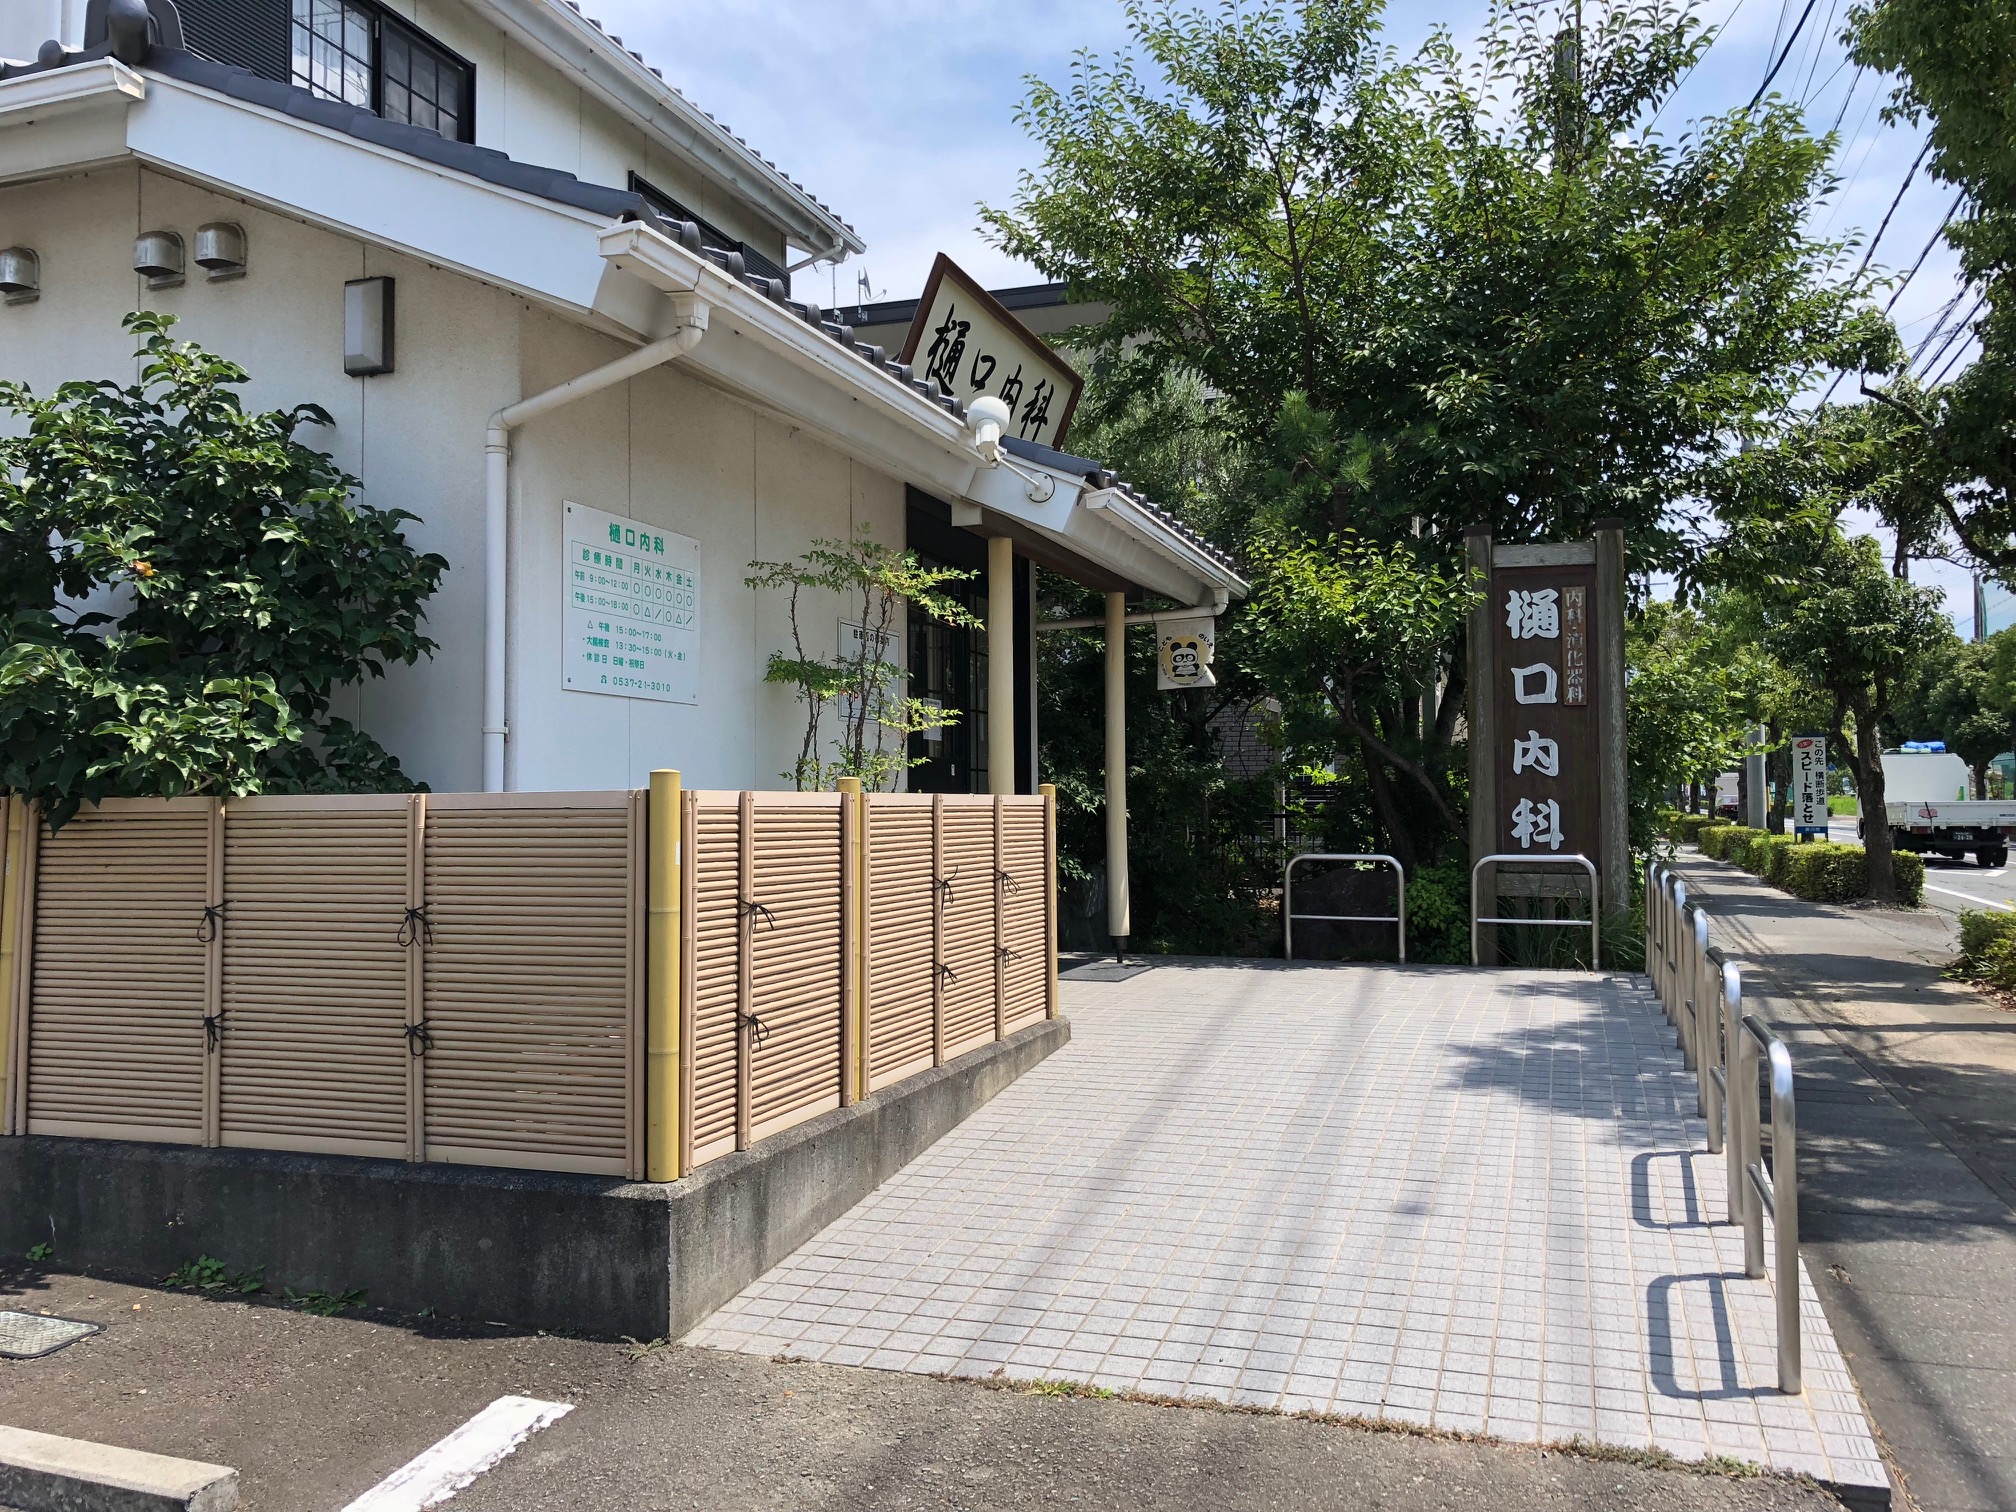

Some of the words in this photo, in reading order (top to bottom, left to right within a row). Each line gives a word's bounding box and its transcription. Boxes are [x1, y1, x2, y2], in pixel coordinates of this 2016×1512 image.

[925, 302, 1054, 442] 樋口内科
[608, 522, 665, 557] 樋口内科
[574, 570, 585, 581] 午前
[582, 548, 623, 570] 診療時間
[633, 562, 640, 574] 月
[644, 565, 652, 577] 火
[655, 568, 662, 580] 水
[665, 571, 672, 582] 木
[676, 574, 683, 585] 金
[686, 576, 692, 588] 土
[574, 592, 586, 603] 午後
[598, 622, 610, 633] 午後
[1565, 590, 1585, 703] 内科・消化器科
[612, 676, 671, 692] 0537-21-3010
[1504, 587, 1565, 851] 樋口内科
[1814, 740, 1824, 766] この先
[1801, 751, 1814, 824] スピード落とせ
[1815, 771, 1825, 805] 横断歩道
